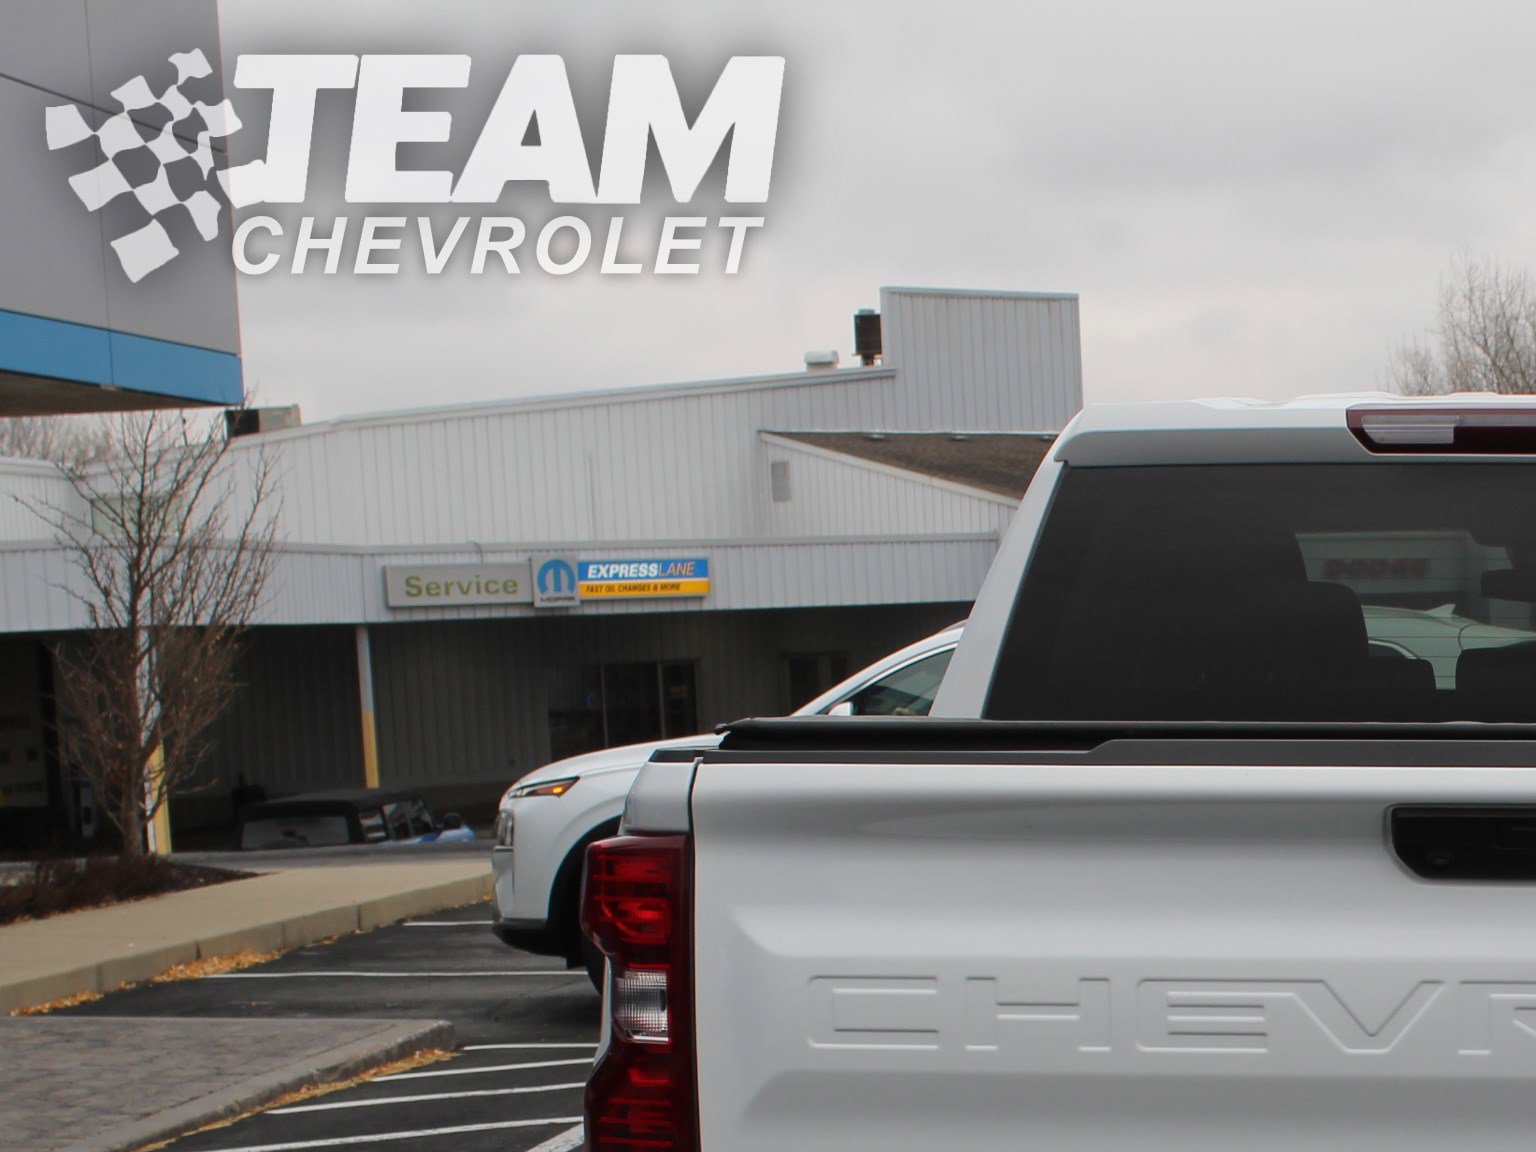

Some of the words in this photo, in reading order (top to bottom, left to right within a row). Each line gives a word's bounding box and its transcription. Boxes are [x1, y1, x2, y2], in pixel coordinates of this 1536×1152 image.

[404, 575, 519, 597] Service
[586, 585, 603, 594] FAST
[605, 585, 615, 593] OIL
[618, 584, 651, 593] CHANGES
[660, 583, 681, 592] MORE
